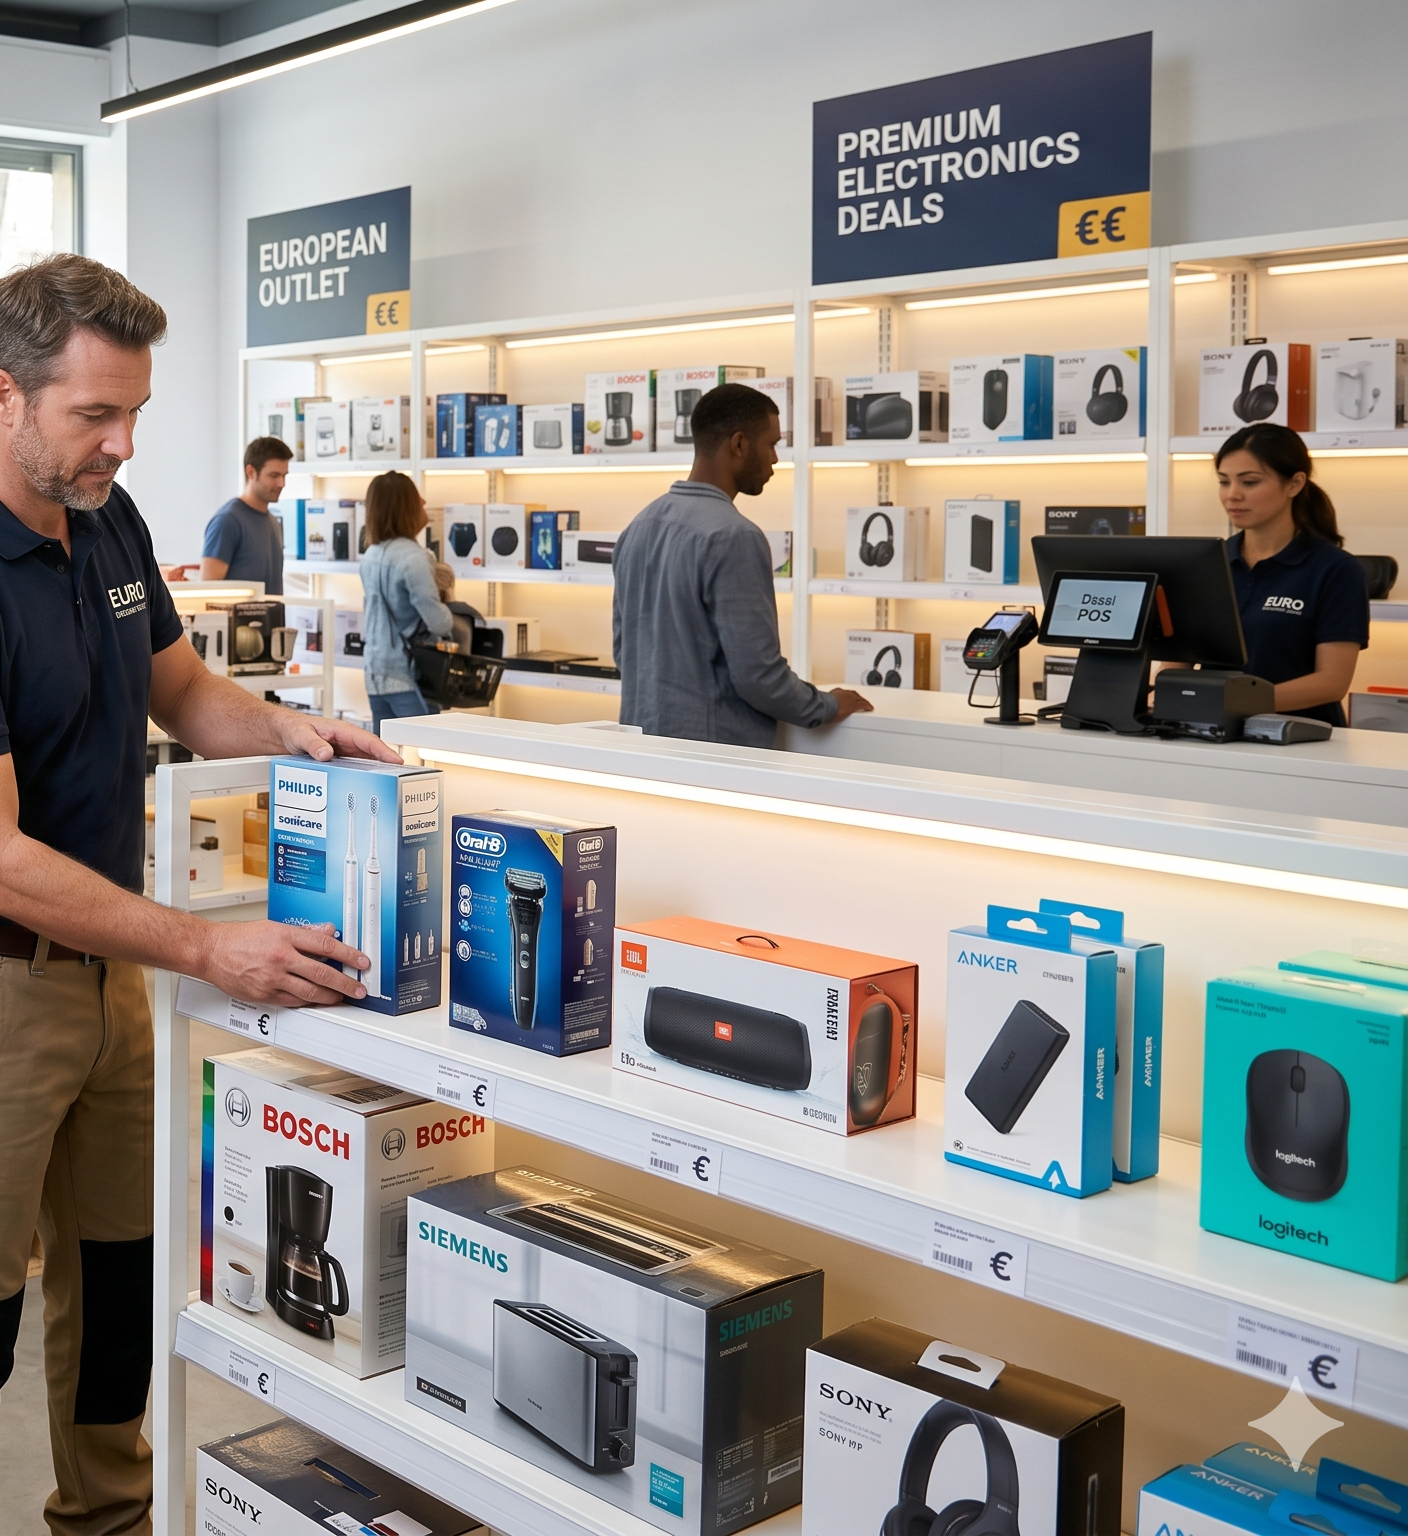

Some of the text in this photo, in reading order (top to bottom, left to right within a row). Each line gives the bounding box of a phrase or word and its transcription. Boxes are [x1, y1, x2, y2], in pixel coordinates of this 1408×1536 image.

[838, 103, 1001, 163] PREMIUM
[838, 131, 1081, 199] ELECTRONICS
[838, 192, 945, 236] DEALS
[1074, 206, 1127, 246] €€
[259, 222, 387, 273] EUROPEAN
[259, 266, 350, 307] OUTLET
[374, 301, 399, 326] €€
[1203, 353, 1233, 361] SONY
[108, 581, 145, 608] EURO
[1264, 596, 1304, 610] EURO
[1077, 609, 1112, 623] POS
[278, 779, 323, 797] PHILIPS
[405, 792, 436, 804] PHILIPS
[460, 832, 501, 853] Oral-B
[957, 950, 1018, 975] ANKER
[257, 1014, 270, 1036] €
[473, 1084, 487, 1107] €
[263, 1103, 350, 1161] BOSCH
[416, 1114, 485, 1149] BOSCH
[692, 1155, 711, 1182] €
[1275, 1149, 1316, 1168] logitech
[1259, 1214, 1329, 1247] logitech
[418, 1221, 509, 1274] SIEMENS
[989, 1251, 1013, 1282] €
[719, 1299, 793, 1343] SIEMENS
[257, 1372, 269, 1395] €
[1308, 1354, 1339, 1390] €
[820, 1383, 893, 1420] SONY
[819, 1427, 847, 1445] SONY
[1244, 1447, 1317, 1477] ANKER
[205, 1477, 262, 1523] SONY
[1189, 1470, 1265, 1501] ANKER
